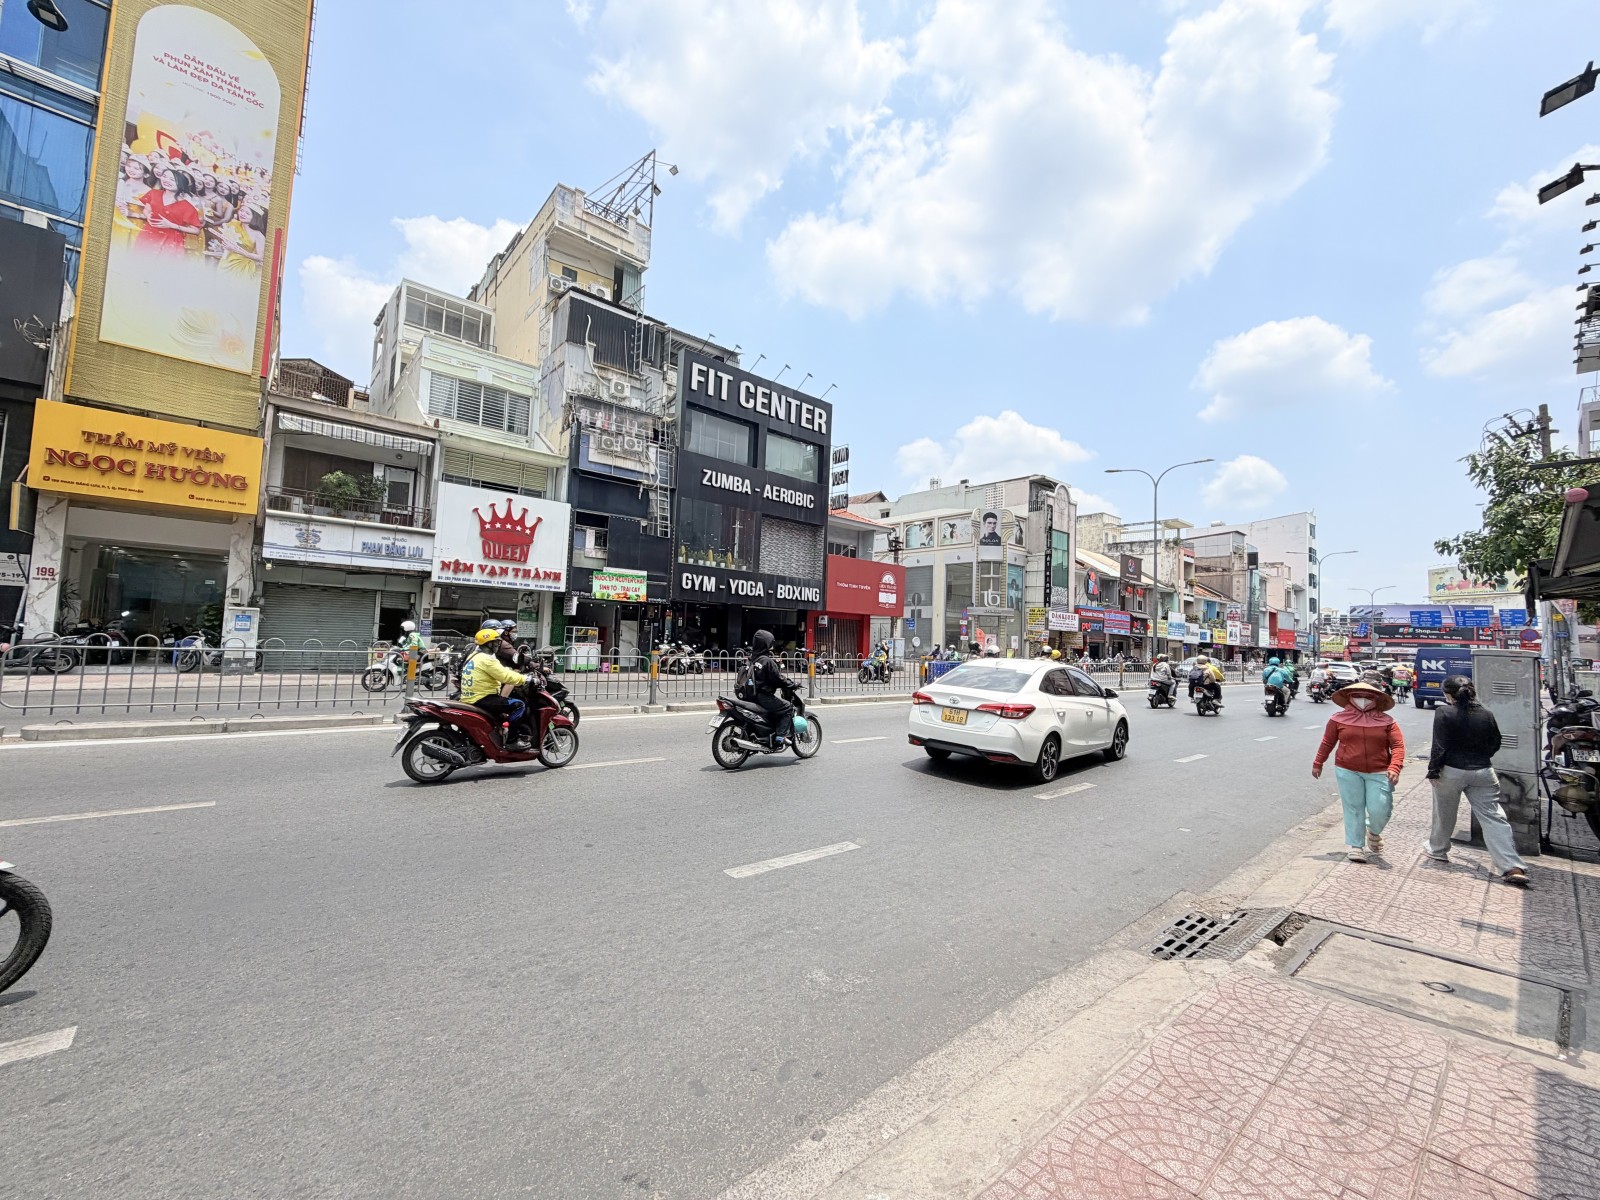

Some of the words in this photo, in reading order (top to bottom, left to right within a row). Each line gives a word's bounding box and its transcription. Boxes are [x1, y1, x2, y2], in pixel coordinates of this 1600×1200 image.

[163, 52, 191, 68] PHUN
[190, 71, 209, 83] ĐẸP
[211, 82, 224, 92] DA
[690, 362, 734, 401] FIT
[739, 380, 827, 435] CENTER
[81, 430, 143, 451] THẨM
[147, 441, 178, 456] MỸ
[182, 446, 226, 464] VIỆN
[44, 447, 137, 476] NGỌC
[144, 462, 248, 490] HƯỜNG
[702, 469, 752, 495] ZUMBA
[763, 484, 814, 509] AEROBIC
[361, 541, 384, 553] PHAN
[385, 542, 406, 556] ĐĂNG
[408, 545, 424, 558] LƯU
[482, 540, 530, 564] QUEEN
[35, 567, 55, 576] 199
[440, 559, 474, 575] NỆM
[478, 564, 509, 577] VẠN
[681, 572, 716, 593] GYM
[729, 578, 764, 598] YOGA
[776, 584, 820, 602] BOXING
[1421, 659, 1447, 671] NK
